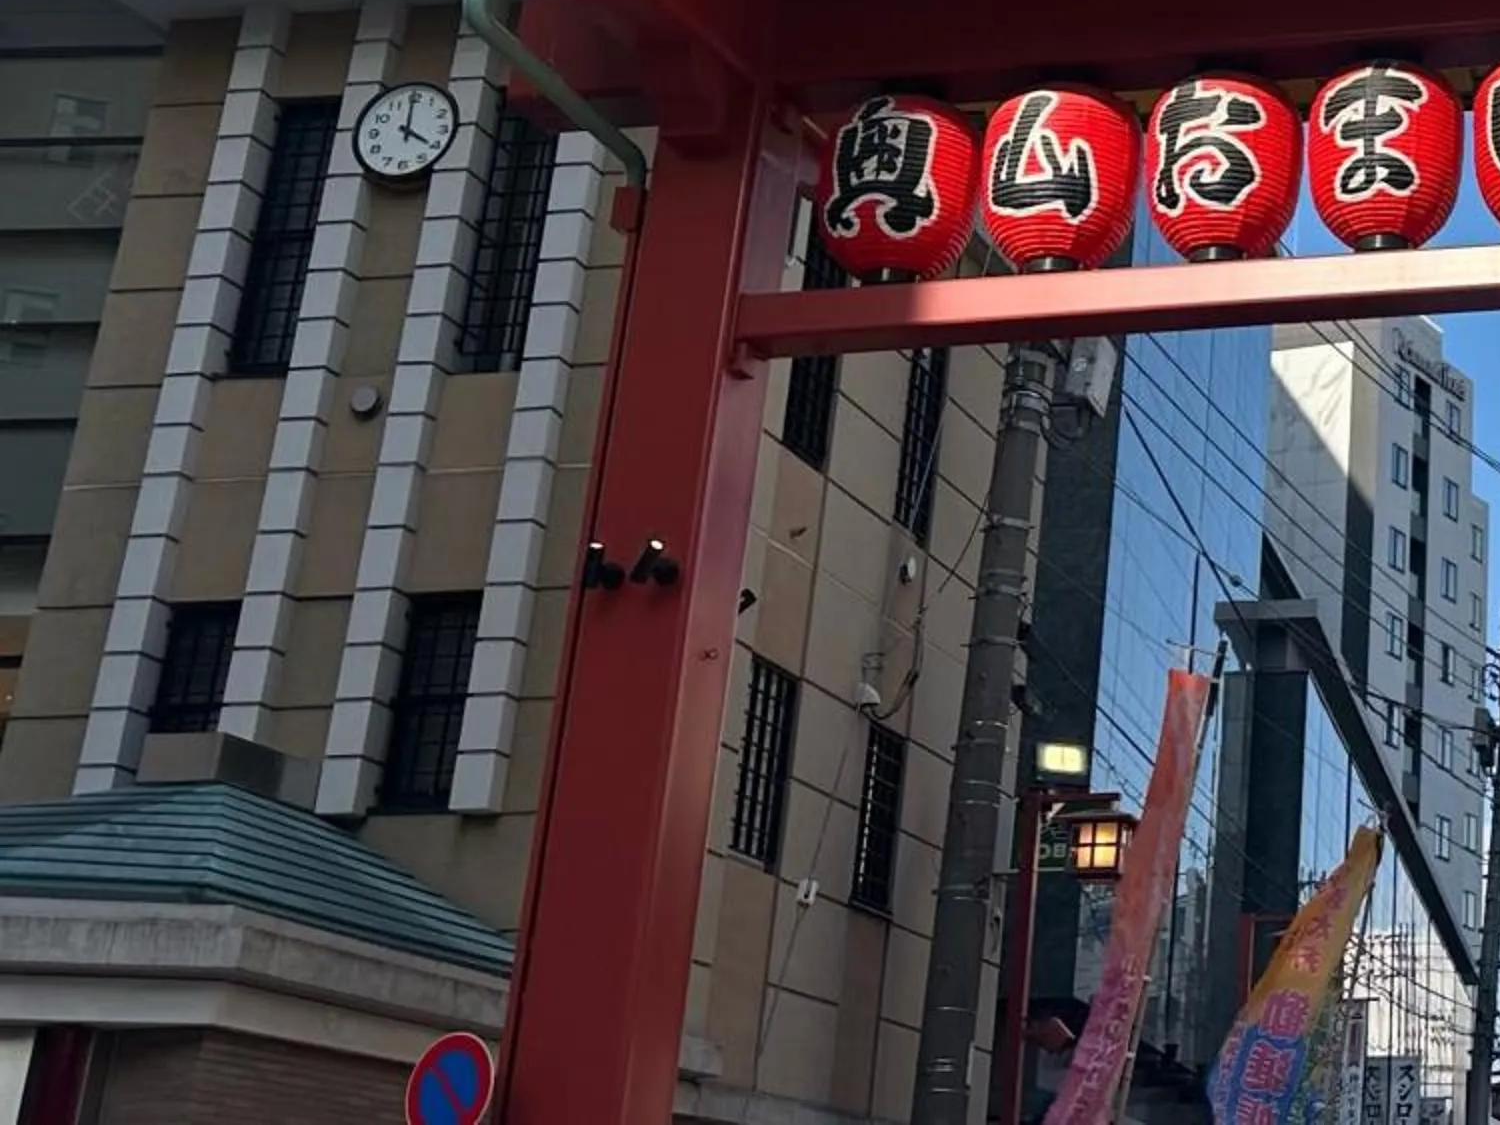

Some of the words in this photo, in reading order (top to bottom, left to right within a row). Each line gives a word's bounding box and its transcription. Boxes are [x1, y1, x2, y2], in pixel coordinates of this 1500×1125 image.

[389, 101, 402, 111] 11
[375, 113, 390, 124] 10
[436, 108, 448, 119] 2
[368, 128, 380, 140] 9
[437, 124, 449, 135] 3
[369, 144, 382, 155] 8
[428, 140, 441, 150] 4
[382, 156, 393, 167] 7
[416, 153, 428, 164] 5
[397, 160, 409, 171] 6
